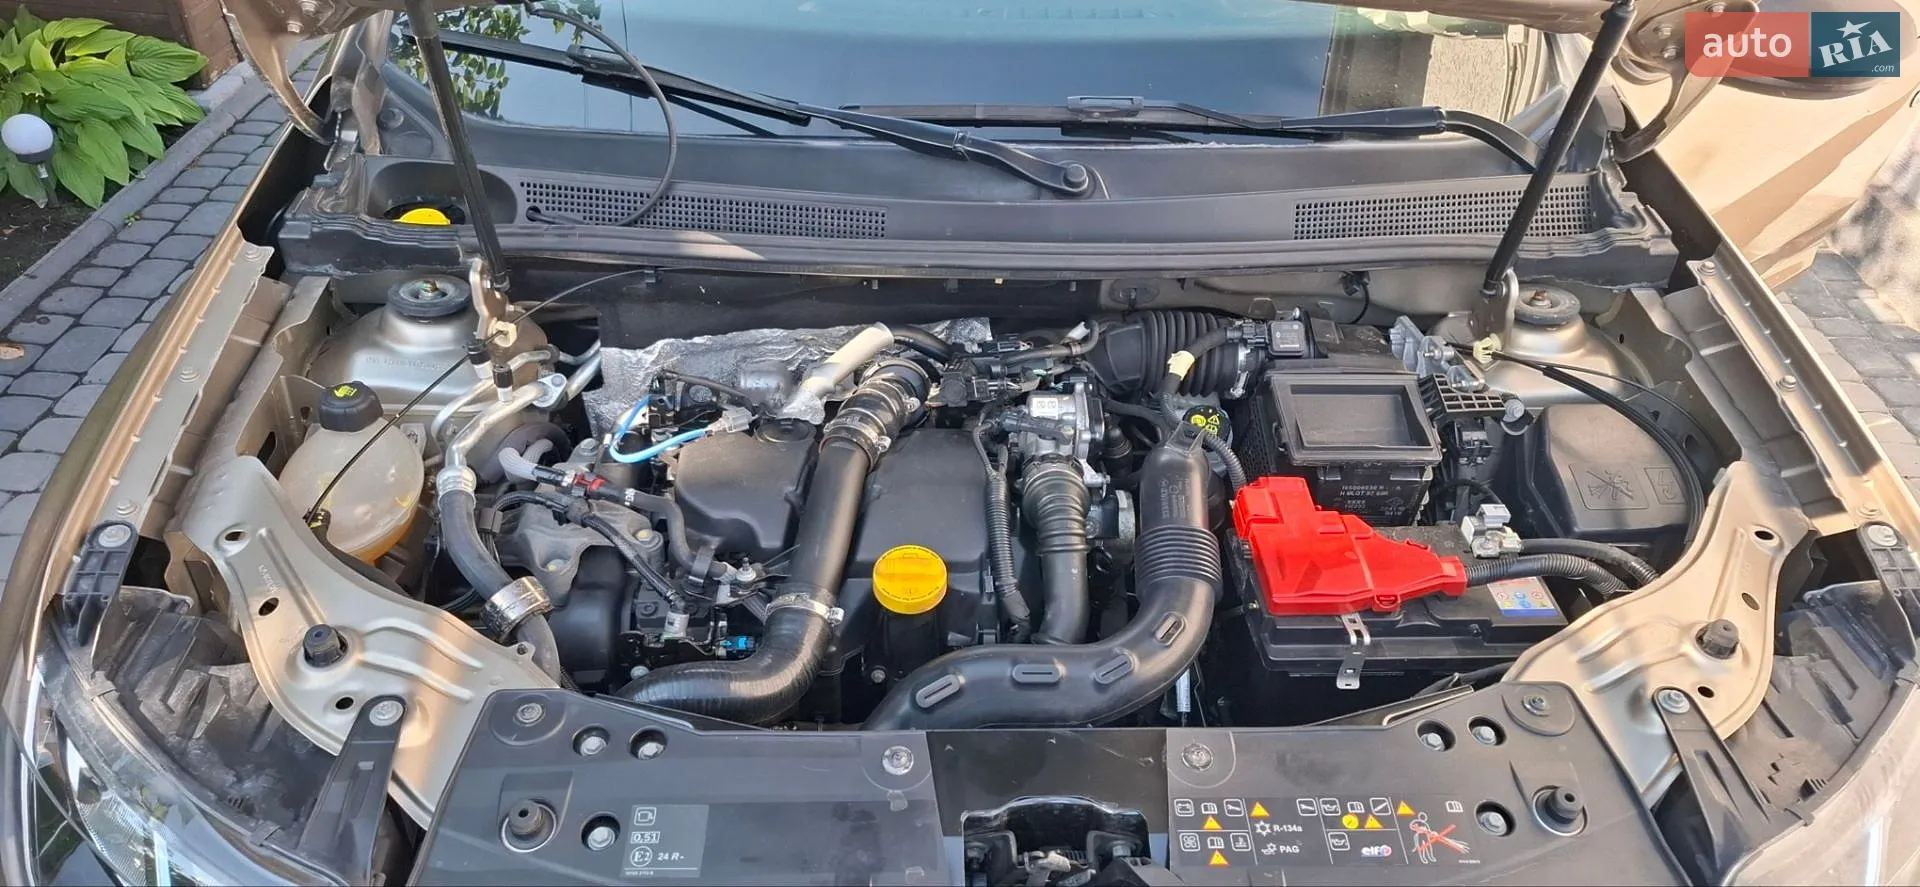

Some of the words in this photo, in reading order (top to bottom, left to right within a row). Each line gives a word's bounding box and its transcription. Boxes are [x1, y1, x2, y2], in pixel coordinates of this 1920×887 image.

[1272, 824, 1303, 832] R-134a
[633, 833, 658, 843] 0.51
[1279, 845, 1300, 853] PAG
